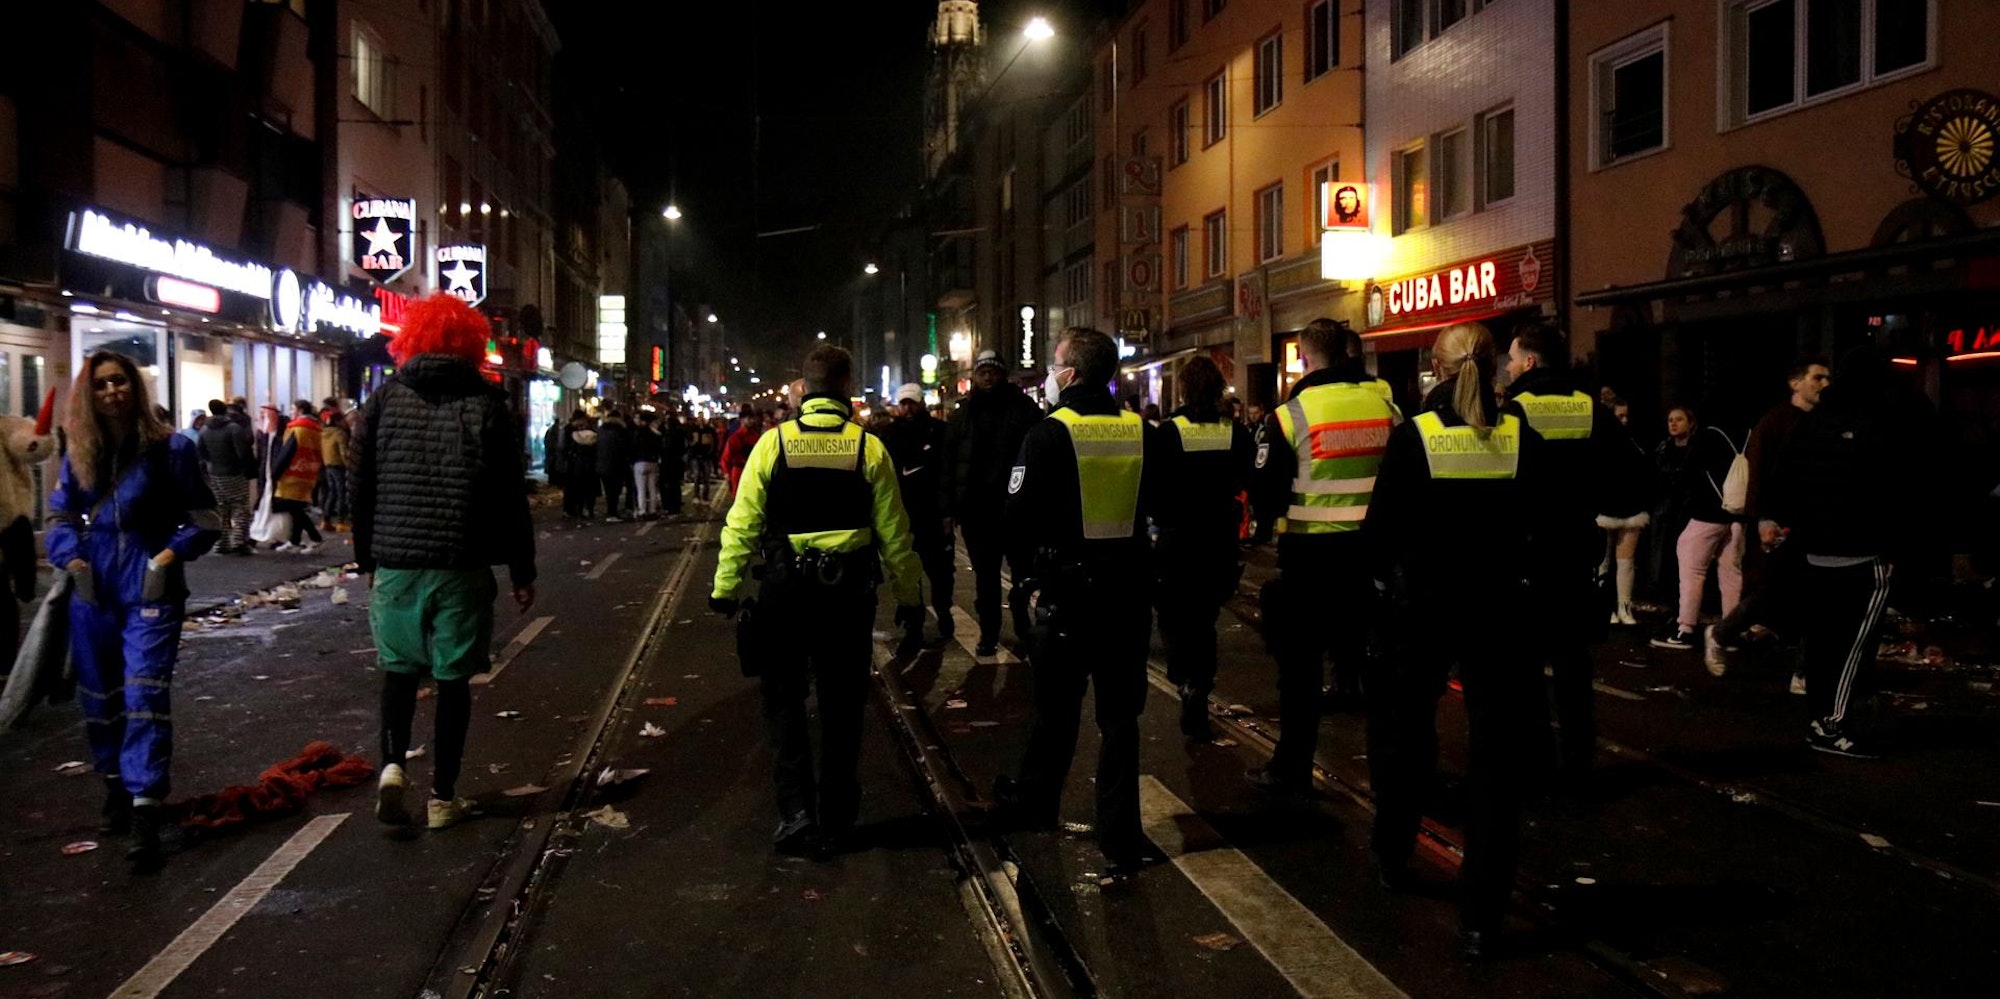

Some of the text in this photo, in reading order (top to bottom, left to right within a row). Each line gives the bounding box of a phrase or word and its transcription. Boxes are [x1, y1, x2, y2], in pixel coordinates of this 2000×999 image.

[353, 200, 410, 220] CUBANA
[362, 254, 404, 269] BAR
[1389, 261, 1497, 314] CUBA BAR
[1526, 402, 1588, 413] ORDNUNGSAMT
[1072, 424, 1139, 438] ORDNUNGSAMT
[787, 439, 857, 453] ORDNUNGSAMT
